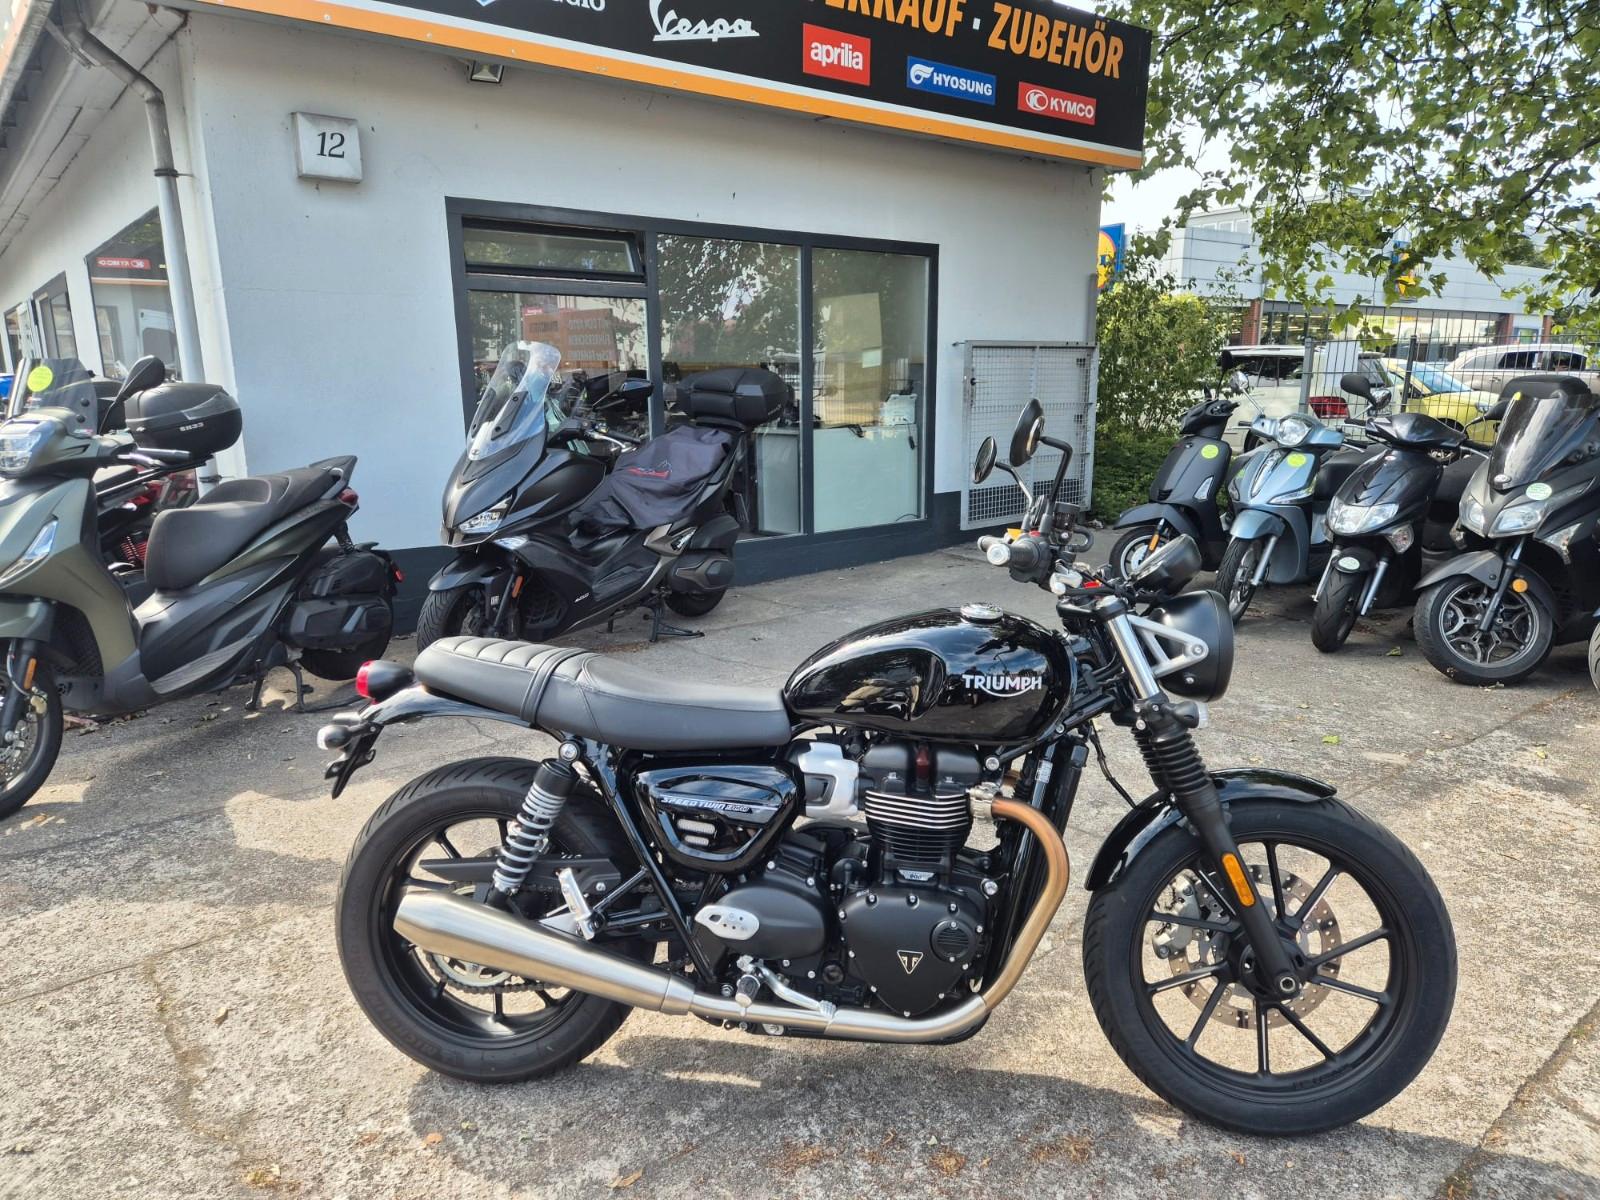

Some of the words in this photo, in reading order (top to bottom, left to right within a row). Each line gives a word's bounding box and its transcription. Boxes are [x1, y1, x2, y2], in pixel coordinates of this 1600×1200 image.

[649, 0, 760, 42] Vespa
[825, 0, 967, 37] KAUF
[988, 2, 1124, 79] ZUBEHÖR
[810, 41, 864, 71] aprilia
[933, 71, 993, 96] HYOSUNG
[1050, 97, 1095, 119] KYMCO
[316, 131, 345, 159] 12
[962, 674, 1043, 697] TRIUMPH
